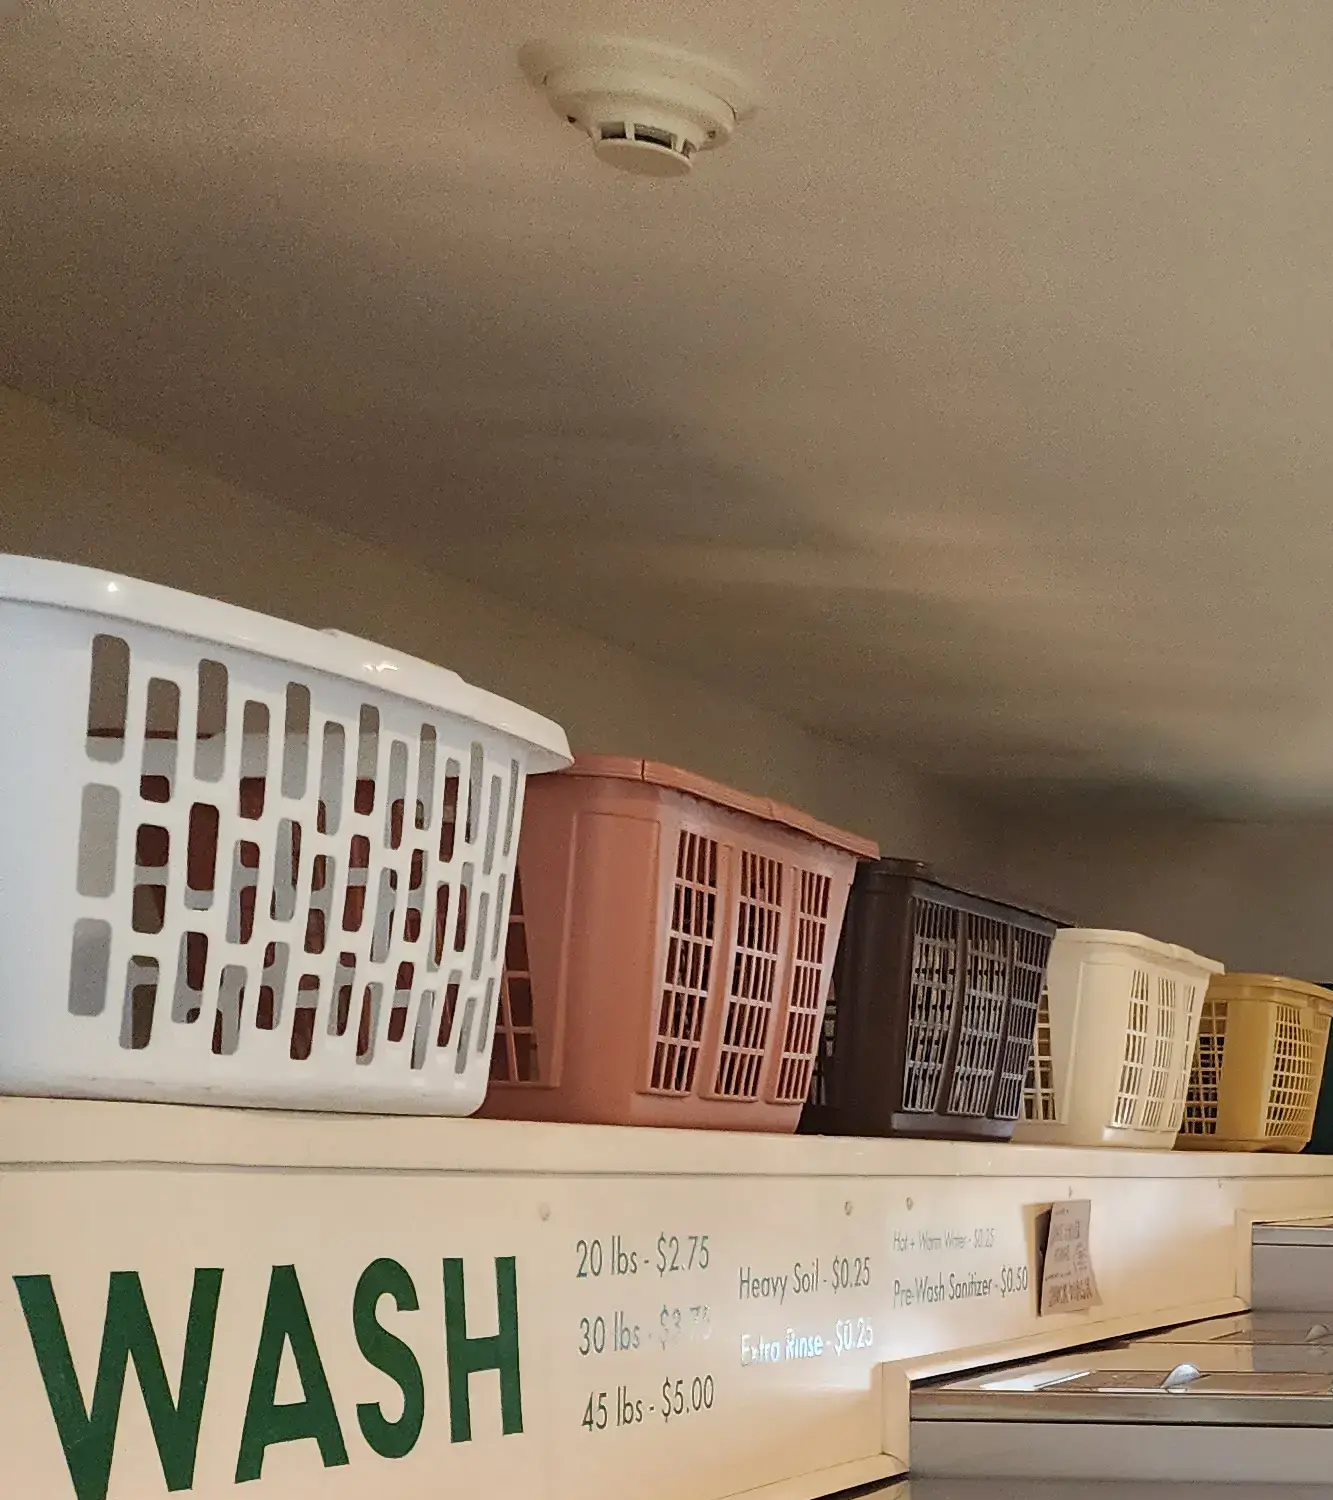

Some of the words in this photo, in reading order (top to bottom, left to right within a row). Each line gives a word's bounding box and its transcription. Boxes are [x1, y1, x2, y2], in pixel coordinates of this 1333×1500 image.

[576, 1239, 603, 1279] 20
[611, 1235, 638, 1276] lbs
[656, 1232, 709, 1278] $2.75
[739, 1266, 788, 1306] Heavy
[793, 1257, 819, 1294] Soil
[832, 1255, 871, 1295] $0.25
[892, 1272, 946, 1309] Pre-Wash
[948, 1271, 993, 1301] Sanitizer
[1000, 1264, 1029, 1298] $0.50
[579, 1316, 606, 1356] 30
[613, 1311, 641, 1352] lbs
[741, 1333, 781, 1367] Extra
[785, 1326, 824, 1360] Rinse
[834, 1317, 875, 1357] $0.25
[581, 1391, 608, 1431] 45
[616, 1385, 644, 1427] lbs
[661, 1375, 714, 1424] $5.00
